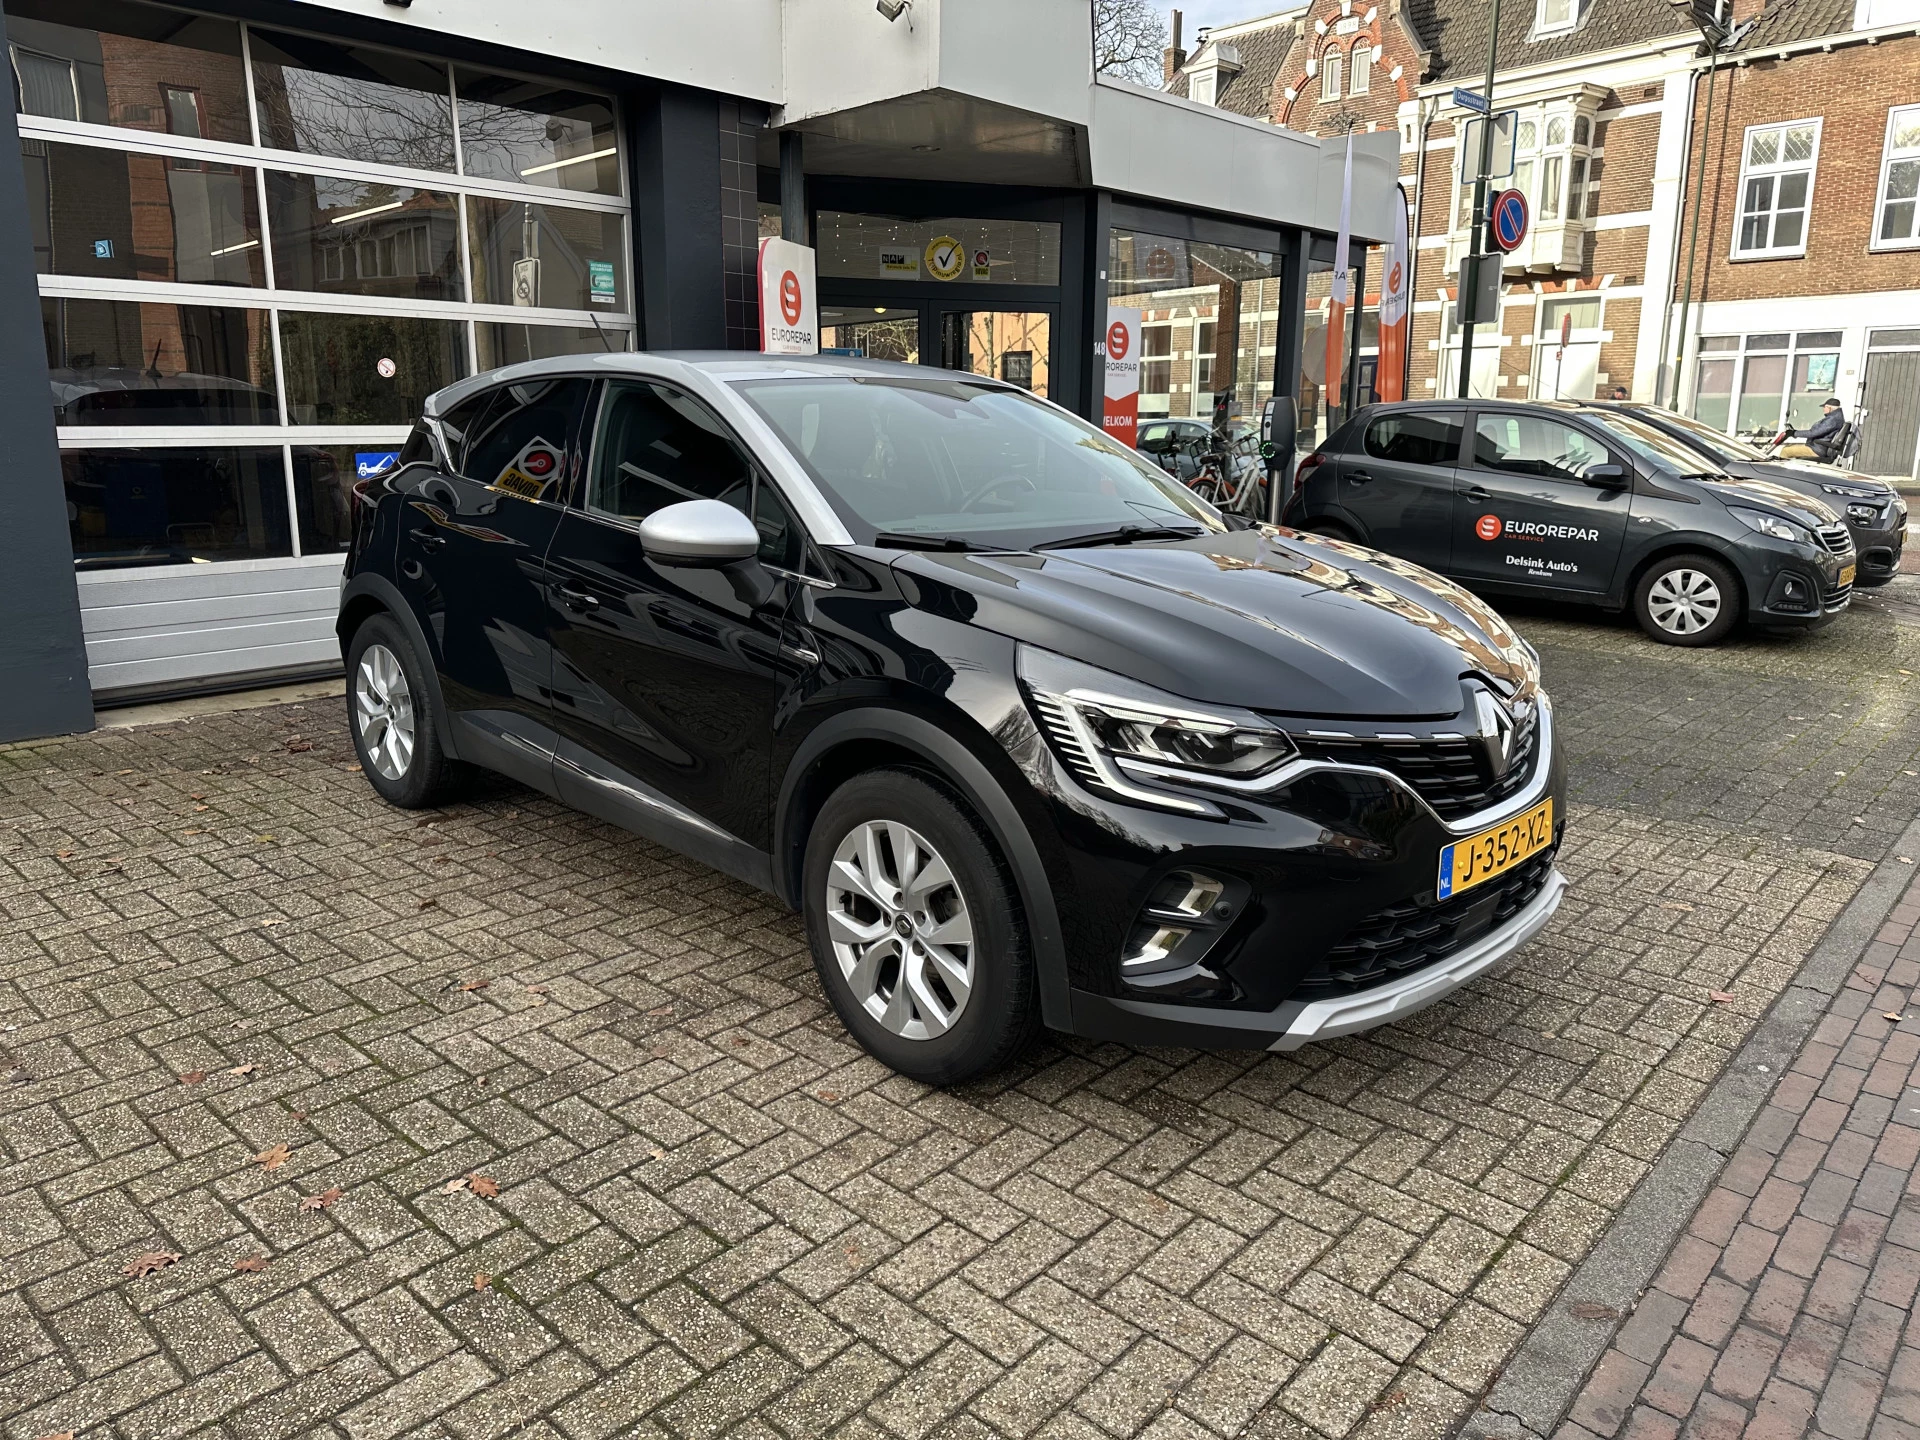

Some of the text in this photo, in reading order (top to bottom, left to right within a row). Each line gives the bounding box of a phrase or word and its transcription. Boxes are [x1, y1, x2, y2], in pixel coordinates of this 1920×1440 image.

[1457, 91, 1484, 107] Dorpsstraat
[882, 254, 904, 263] NAP
[771, 327, 812, 345] EUROREPAR
[1094, 341, 1106, 356] 148
[1105, 362, 1137, 372] ROREPAR
[1505, 520, 1599, 542] EUROREPAR
[1506, 555, 1578, 573] Delsink Auto's
[1528, 569, 1553, 577] Renkum
[1440, 808, 1546, 890] NL J-352-XZ
